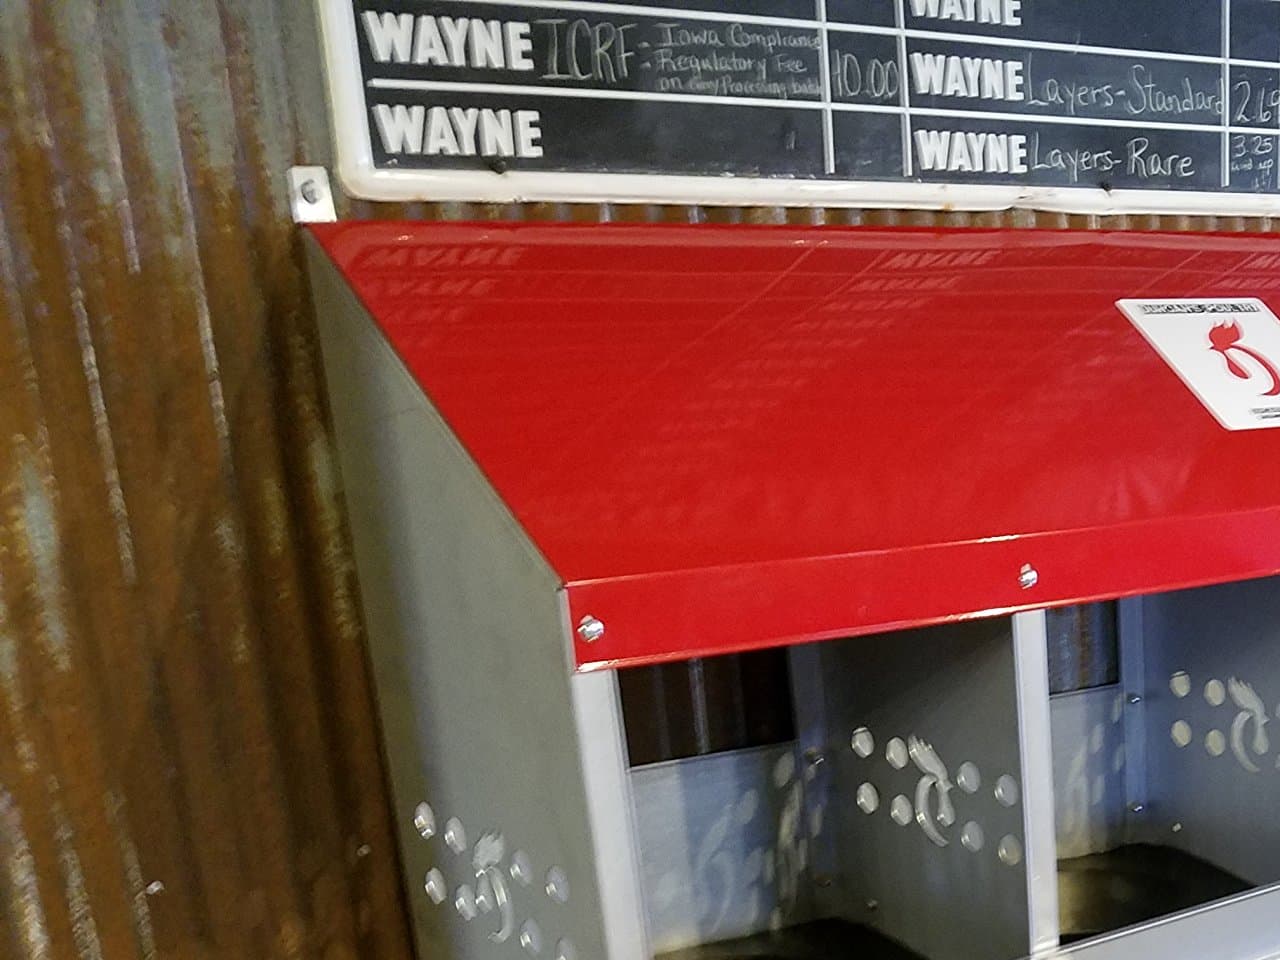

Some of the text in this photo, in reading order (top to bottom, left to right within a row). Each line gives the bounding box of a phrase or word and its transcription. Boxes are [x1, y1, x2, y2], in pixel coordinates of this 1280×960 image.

[360, 11, 534, 71] WAYNE
[652, 23, 725, 47] Iowa
[653, 49, 808, 80] Regulatory Fee
[910, 52, 1025, 101] WAYNE
[374, 104, 543, 158] WAYNE
[914, 129, 1028, 174] WAYNE
[1127, 137, 1195, 177] Rare
